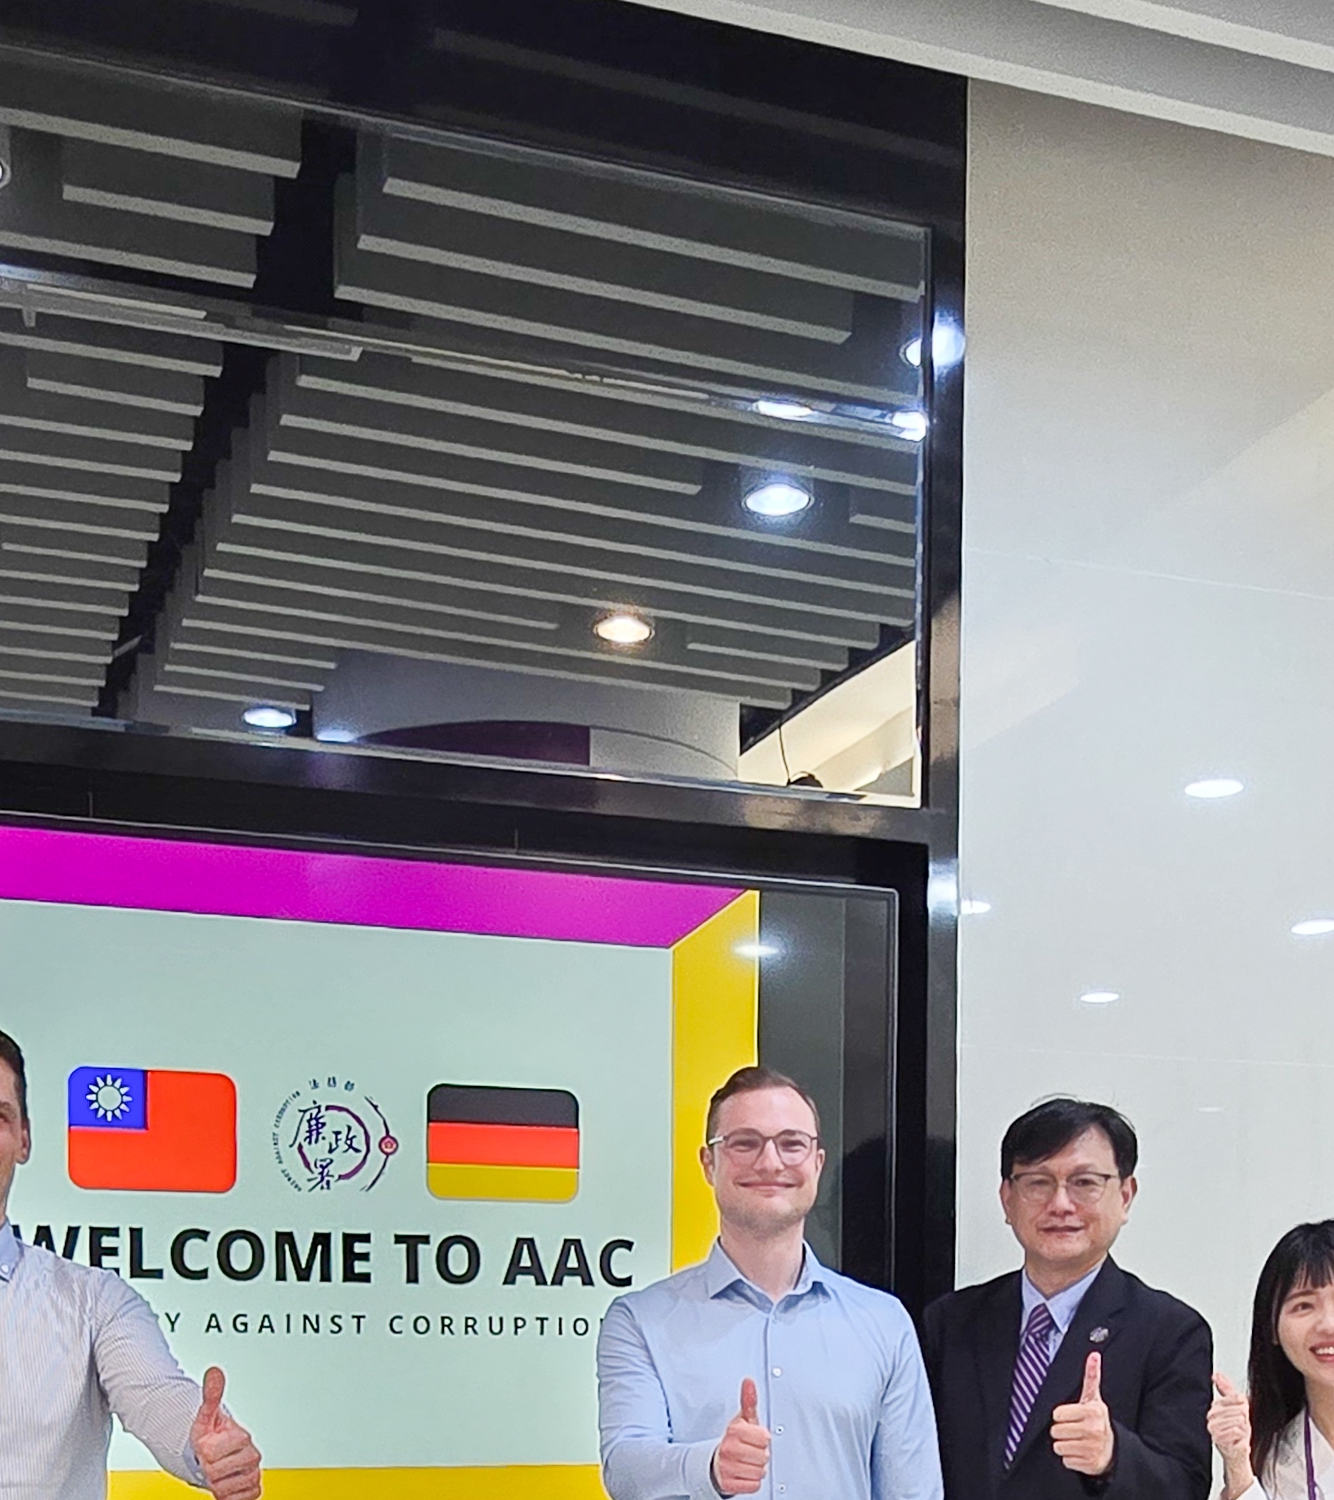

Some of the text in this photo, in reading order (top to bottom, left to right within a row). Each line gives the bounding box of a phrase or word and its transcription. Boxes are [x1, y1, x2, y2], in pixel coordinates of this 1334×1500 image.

[394, 1234, 481, 1284] TO
[503, 1237, 634, 1287] AAC
[205, 1313, 366, 1335] AGAINST
[389, 1315, 604, 1336] CORRUPTIO
